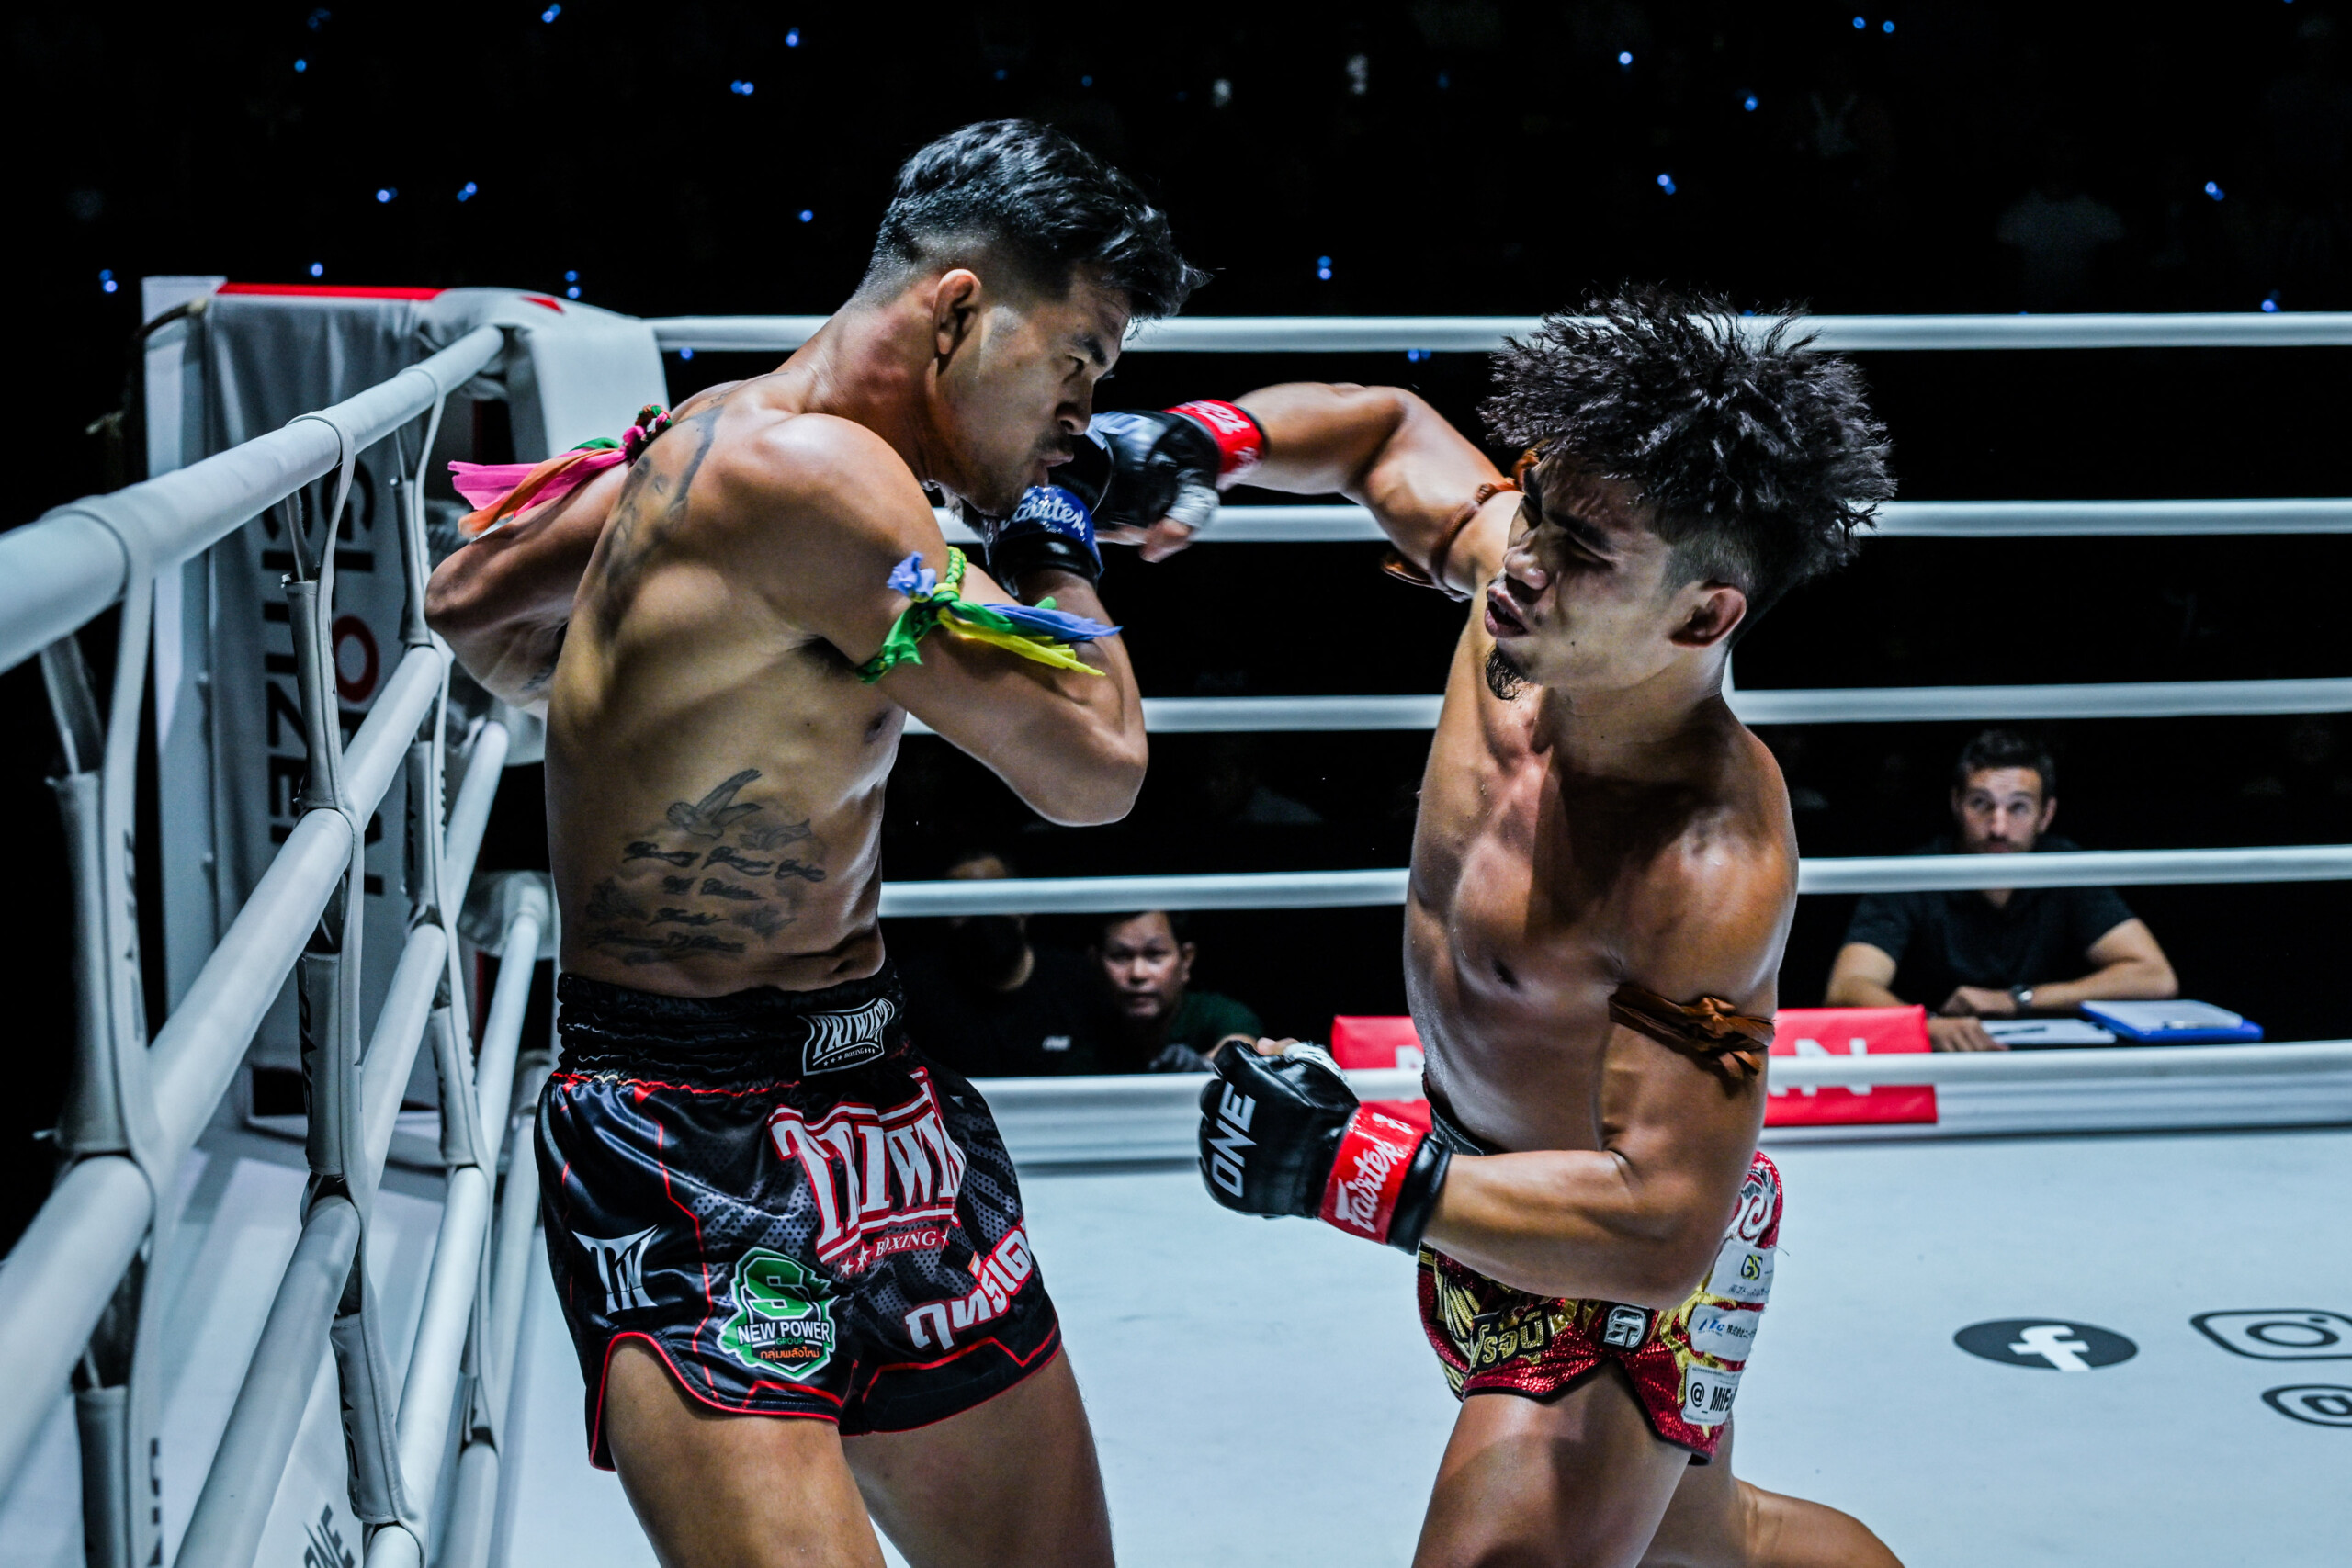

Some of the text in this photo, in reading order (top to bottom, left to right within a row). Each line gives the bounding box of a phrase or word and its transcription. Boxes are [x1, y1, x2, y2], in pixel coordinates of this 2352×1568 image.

[999, 488, 1086, 531] airtex
[1206, 1081, 1257, 1198] ONE
[1335, 1134, 1399, 1233] Fairtex
[876, 1230, 937, 1257] BOXING
[737, 1321, 831, 1345] NEW POWER
[775, 1337, 804, 1346] GROUP
[760, 1345, 820, 1361] กลุ่มพลังใหม่
